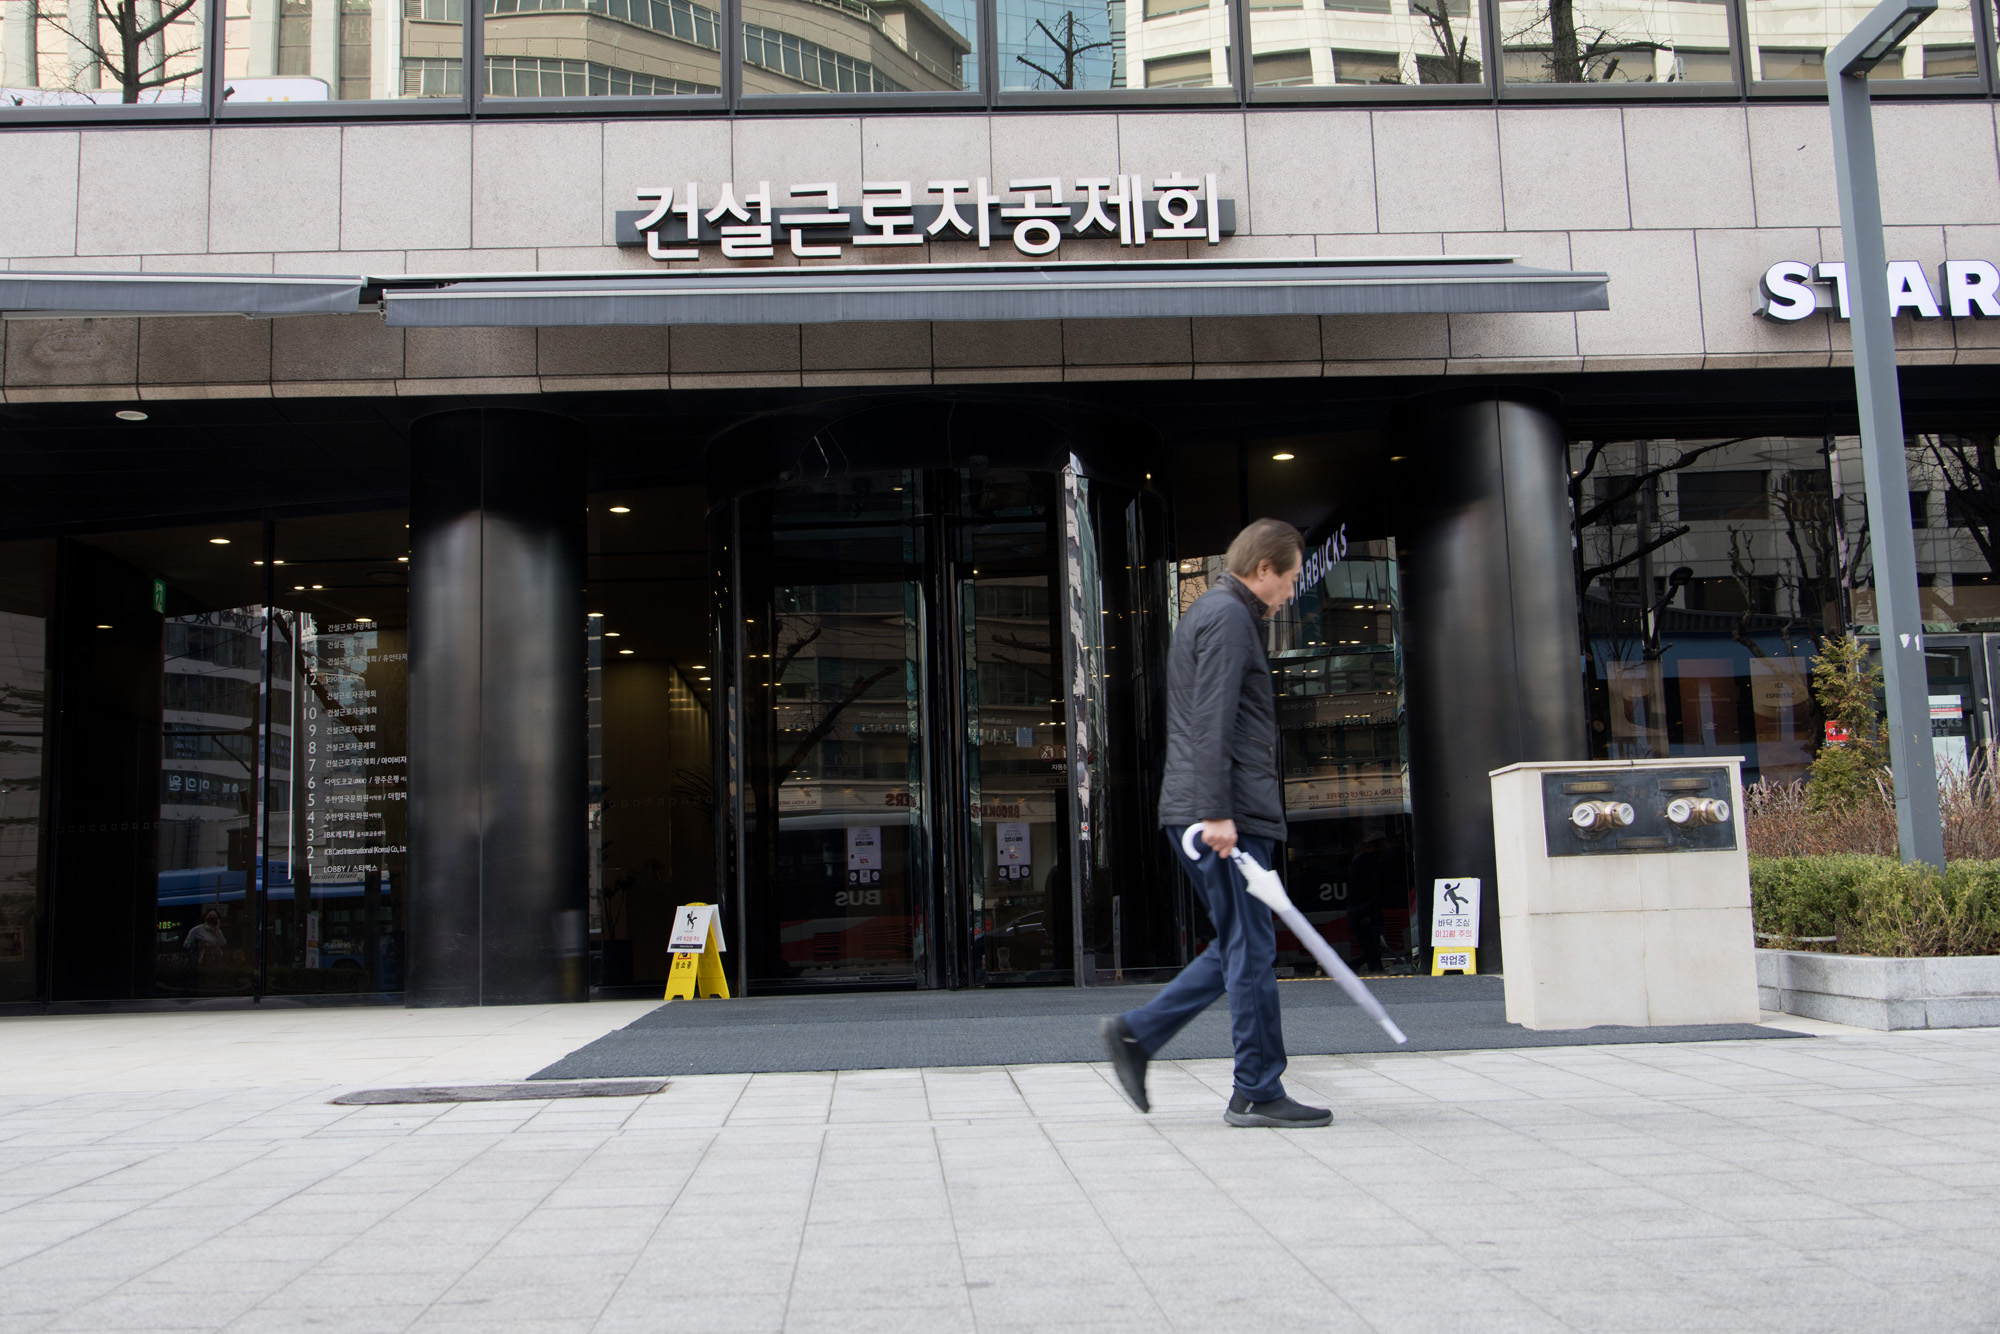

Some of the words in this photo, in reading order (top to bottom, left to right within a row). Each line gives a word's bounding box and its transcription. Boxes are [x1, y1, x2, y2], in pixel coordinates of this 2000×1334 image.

[634, 172, 1219, 260] 건설근로자공제회
[328, 622, 377, 632] 건설근로자공제회
[305, 656, 317, 668] 13
[305, 673, 317, 685] 12
[304, 690, 314, 702] 11
[327, 690, 376, 700] 건설근로자공제회
[304, 707, 316, 720] 10
[328, 707, 377, 717] 건설근로자공제회
[309, 725, 316, 736] 9
[326, 725, 376, 735] 건설근로자공제회
[308, 742, 316, 754] 8
[326, 742, 375, 752] 건설근로자공제회
[308, 759, 316, 772] 7
[325, 758, 375, 767] 건설근로자공제회
[308, 776, 315, 789] 6
[307, 793, 315, 806] 5
[307, 811, 315, 823] 4
[307, 828, 314, 841] 3
[306, 846, 314, 859] 2
[308, 863, 312, 876] 1
[324, 865, 346, 873] LOBBY
[352, 864, 378, 872] 스타벅스
[1438, 919, 1453, 927] 바닥
[1455, 919, 1470, 927] 조심
[1435, 929, 1456, 938] 미끄럼
[1458, 929, 1472, 938] 주의
[1440, 955, 1467, 966] 작업중
